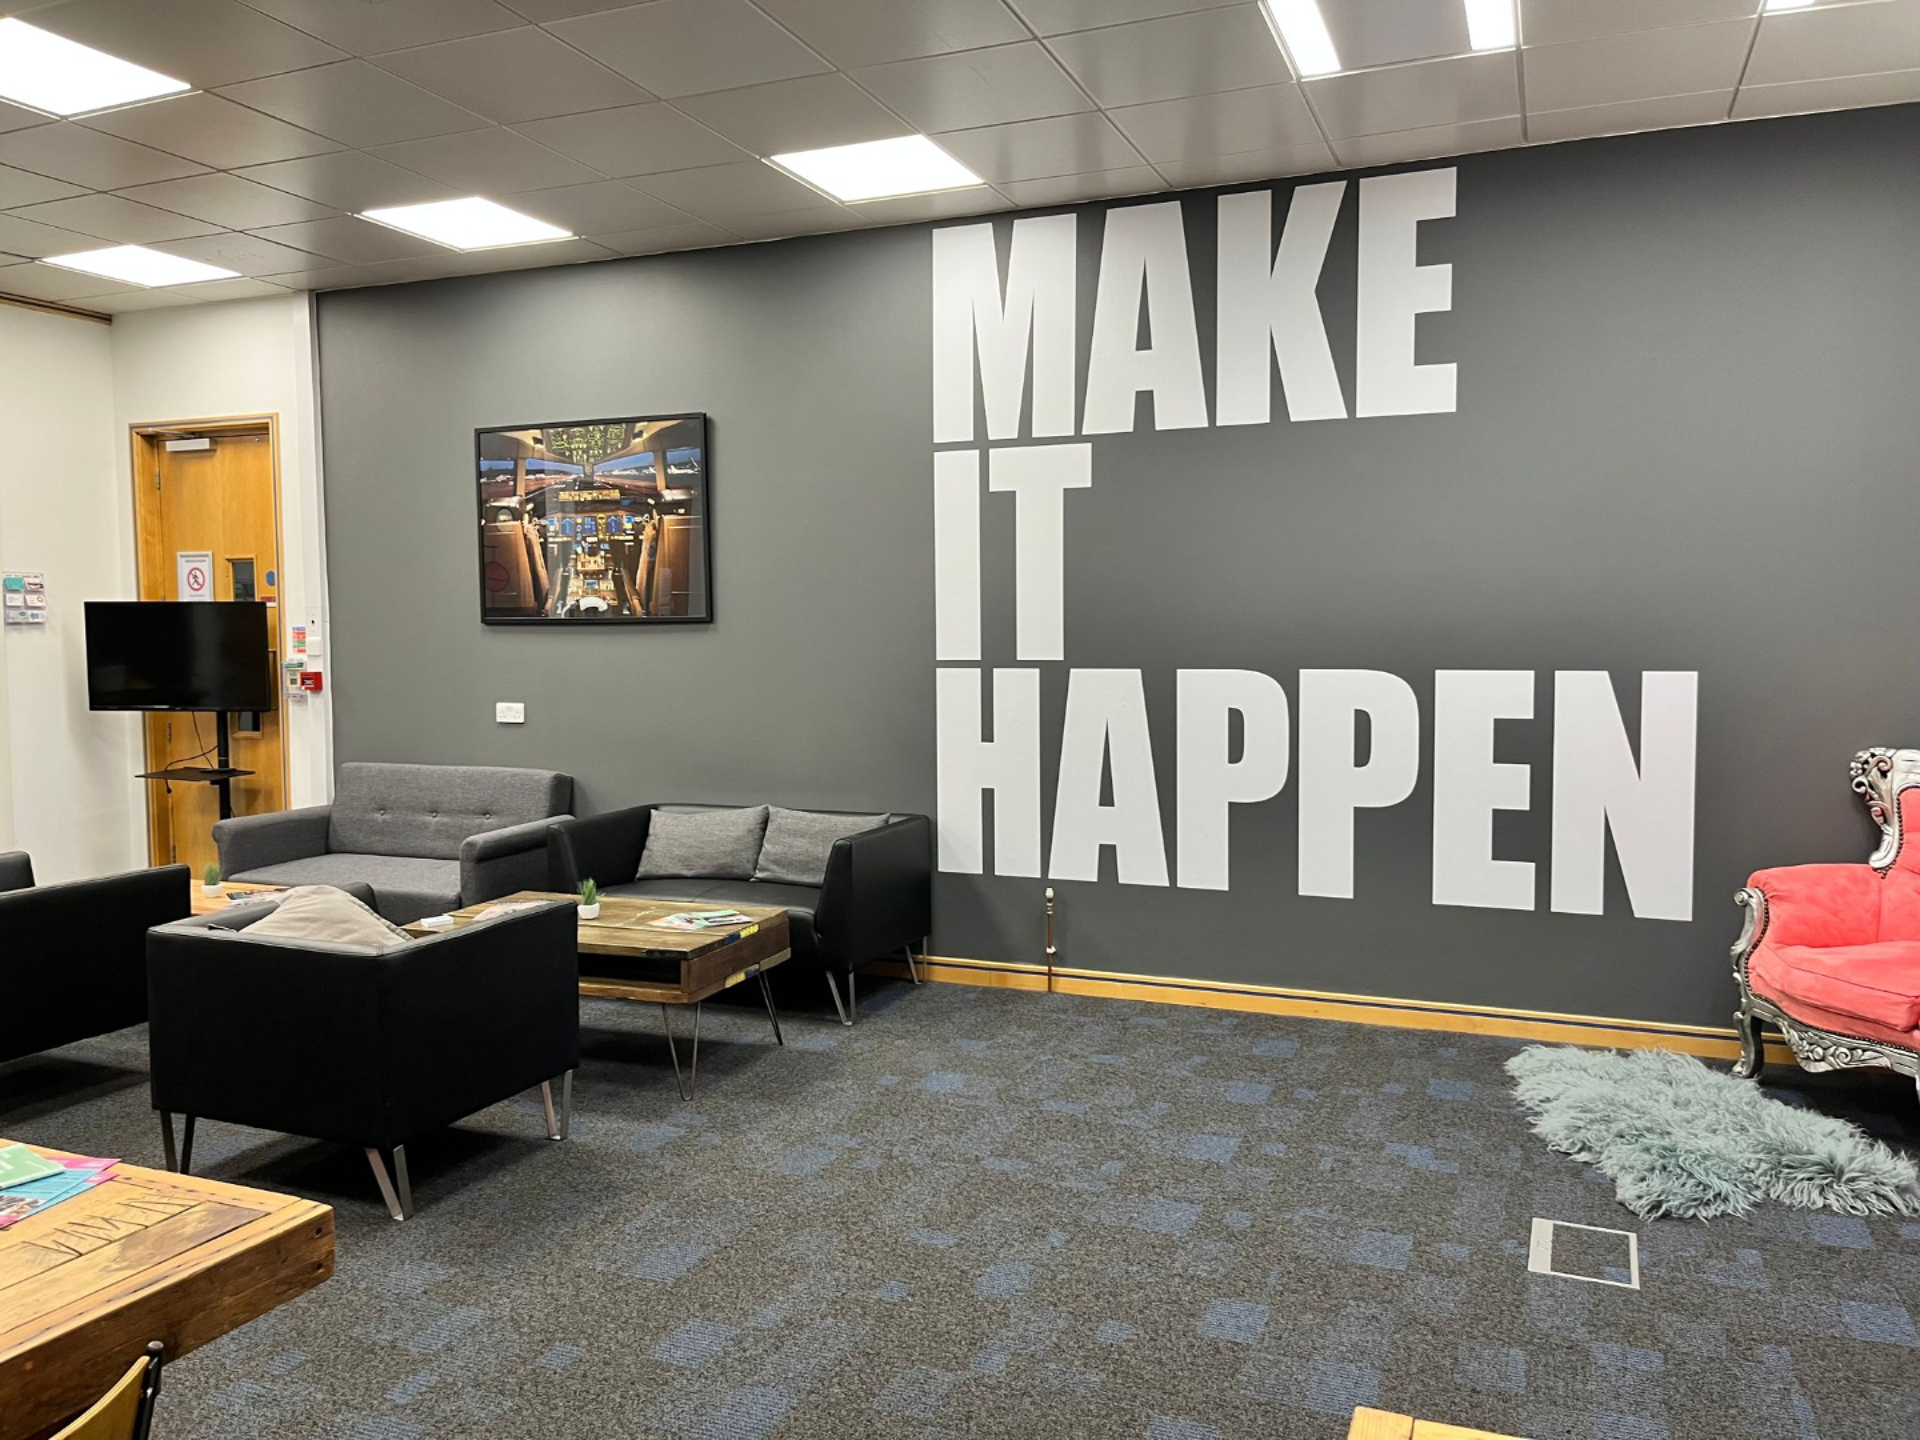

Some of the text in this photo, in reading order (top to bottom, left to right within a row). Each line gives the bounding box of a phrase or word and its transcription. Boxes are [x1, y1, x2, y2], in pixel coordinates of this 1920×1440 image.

[932, 167, 1458, 444] MAKE
[933, 443, 1093, 661] IT
[935, 668, 1699, 922] HAPPEN
